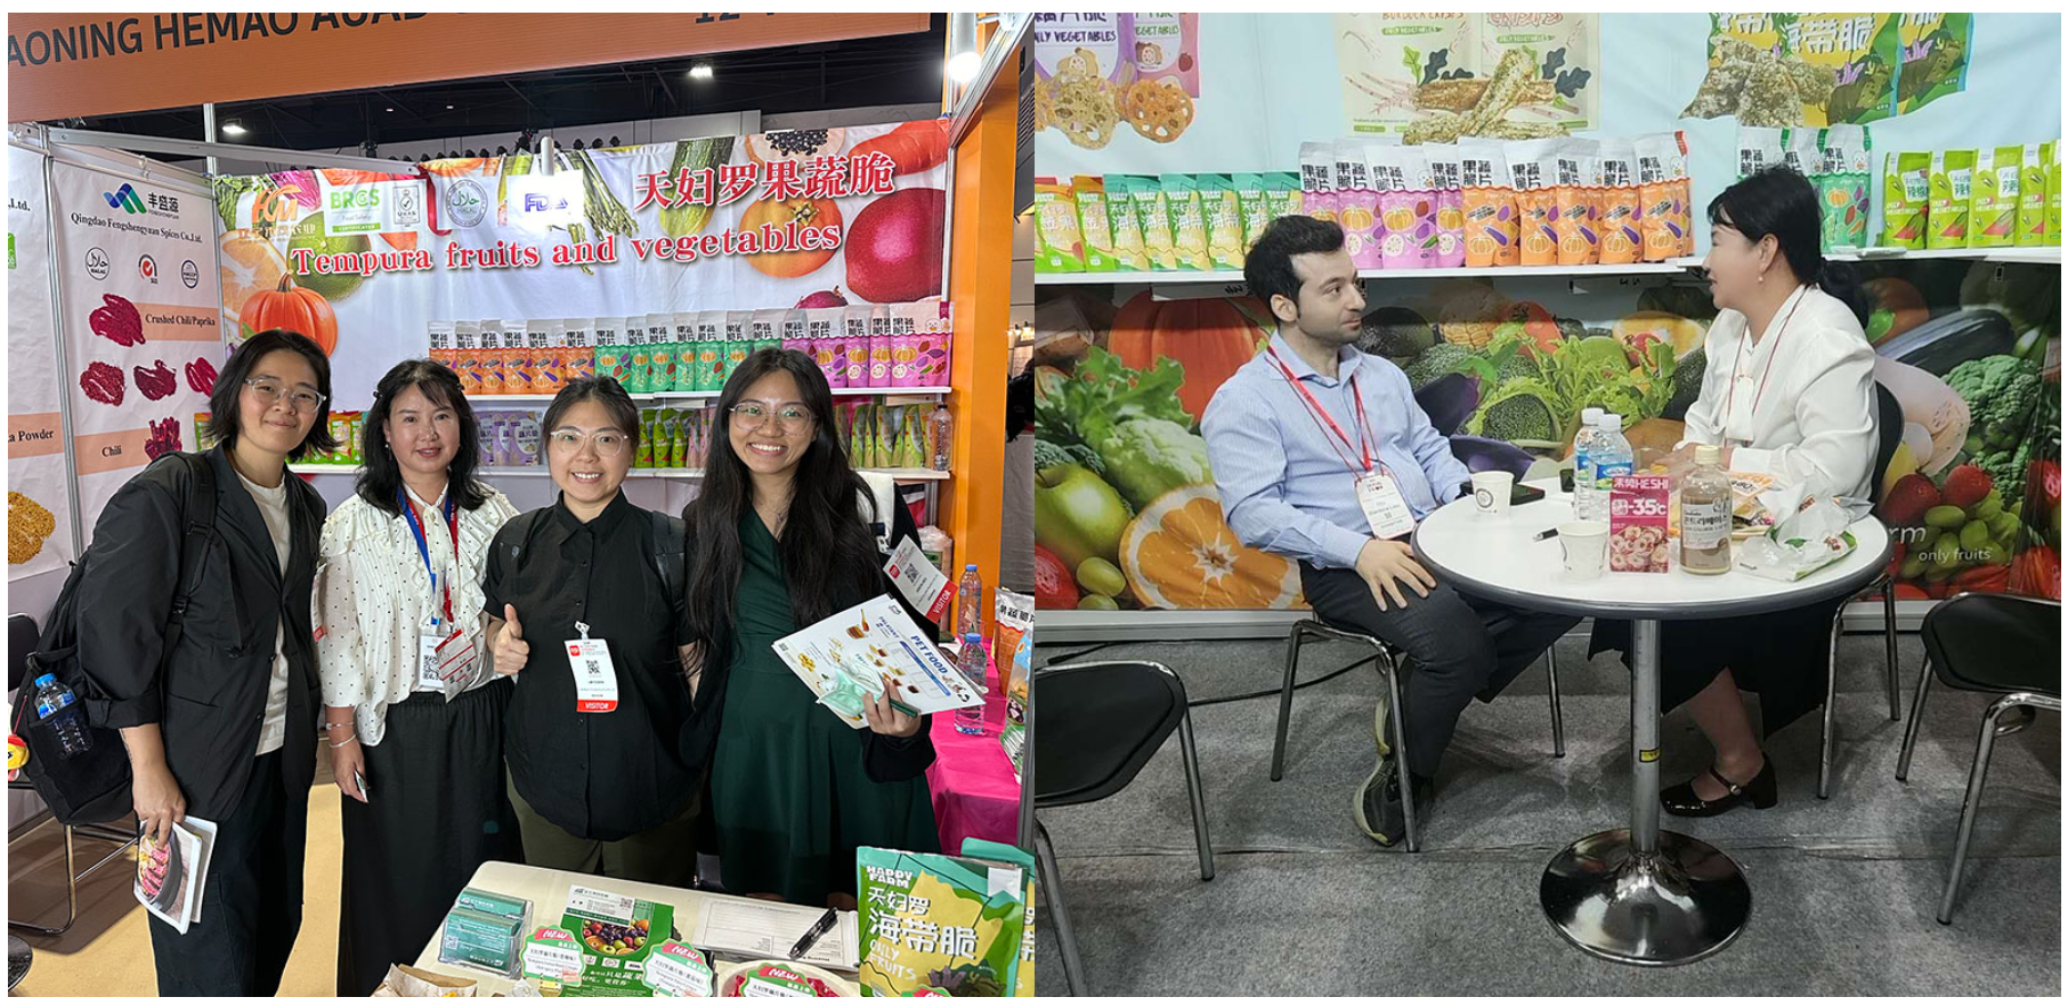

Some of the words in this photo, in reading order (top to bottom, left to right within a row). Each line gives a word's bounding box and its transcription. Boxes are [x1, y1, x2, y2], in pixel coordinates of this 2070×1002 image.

[1054, 31, 1117, 42] VEGETABLES
[634, 152, 896, 212] 天妇罗果蔬脆
[71, 212, 107, 227] Qingdao
[291, 249, 432, 277] Tempura
[446, 240, 540, 268] fruits
[551, 235, 616, 264] and
[631, 222, 842, 262] vegetables
[145, 314, 175, 324] Crushed
[18, 429, 54, 442] Powder
[102, 445, 122, 457] Chili
[1918, 548, 1950, 564] only
[1953, 547, 1992, 562] fruits
[932, 588, 952, 615] VISITOR
[911, 635, 929, 651] PET
[924, 651, 948, 674] FOOD
[867, 865, 912, 881] HAPPY
[869, 874, 911, 889] FARM
[867, 886, 931, 916] 天妇罗
[543, 929, 567, 939] NEW
[868, 906, 979, 961] 海带脆
[671, 945, 699, 960] NEW
[869, 938, 900, 961] ONLY
[768, 968, 799, 981] NEW
[869, 953, 917, 981] FRUITS
